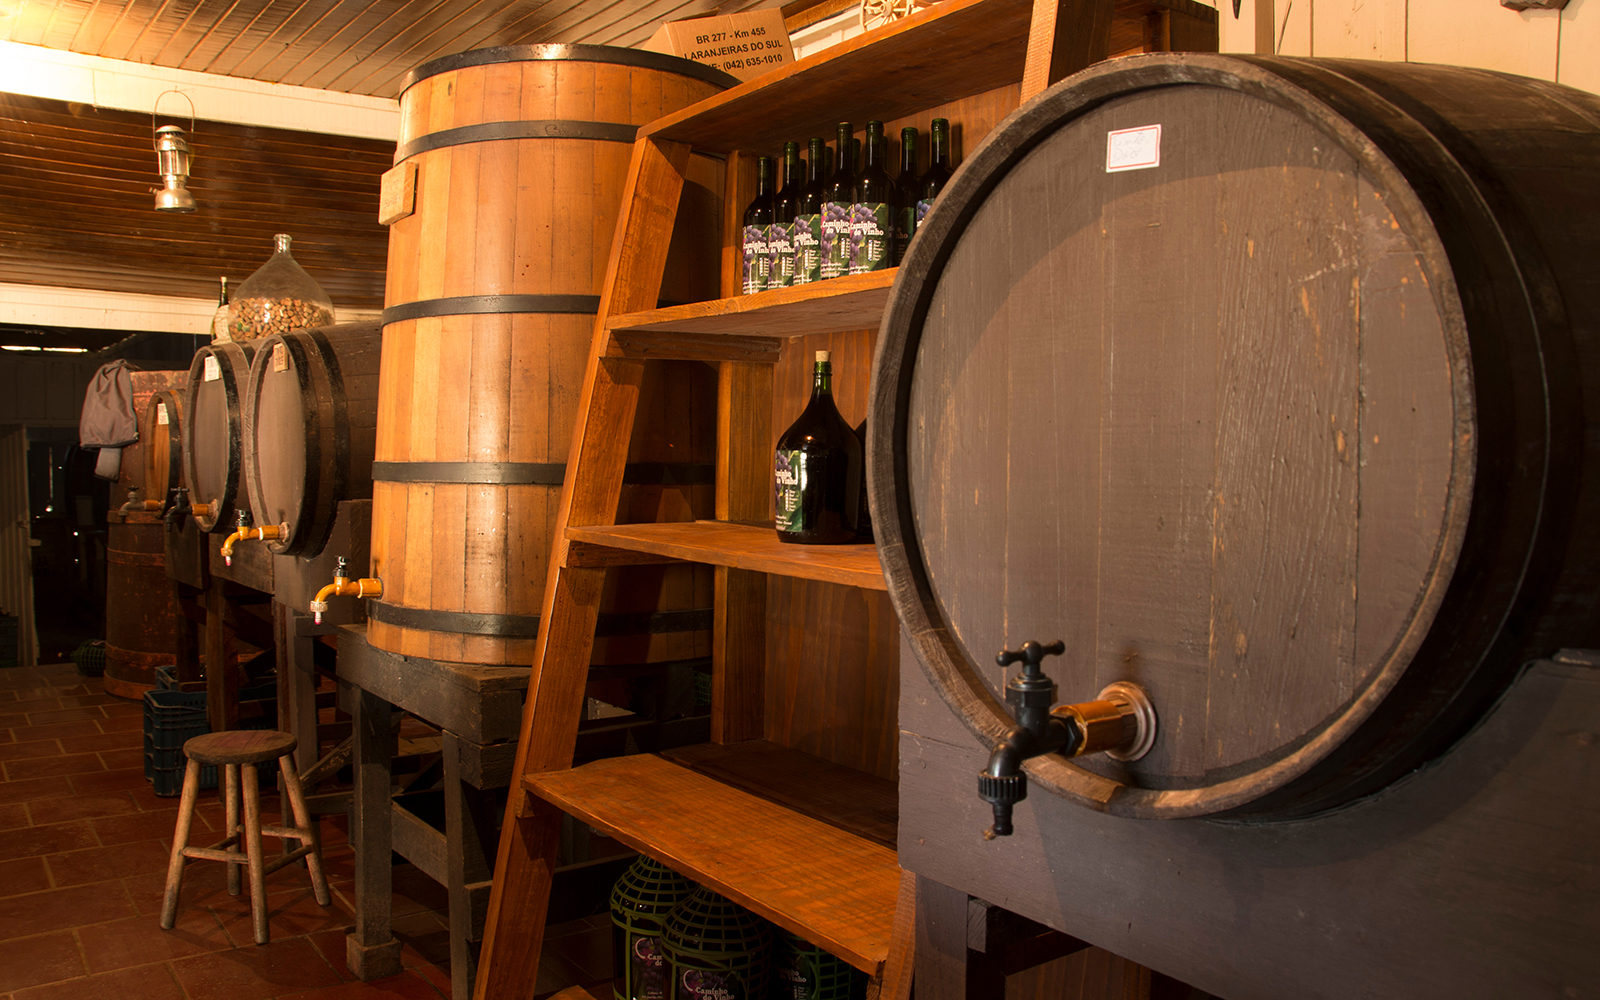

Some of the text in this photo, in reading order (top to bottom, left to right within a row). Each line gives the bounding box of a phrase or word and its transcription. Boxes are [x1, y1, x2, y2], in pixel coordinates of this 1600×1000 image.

[696, 34, 710, 45] BR
[712, 32, 726, 42] 277
[734, 29, 749, 39] Km
[751, 27, 766, 37] 455
[750, 41, 764, 51] DO
[765, 39, 783, 49] SUL
[723, 60, 745, 72] (042)
[746, 53, 783, 67] 635-1010
[862, 226, 884, 236] Vinho
[695, 986, 728, 995] Caminho
